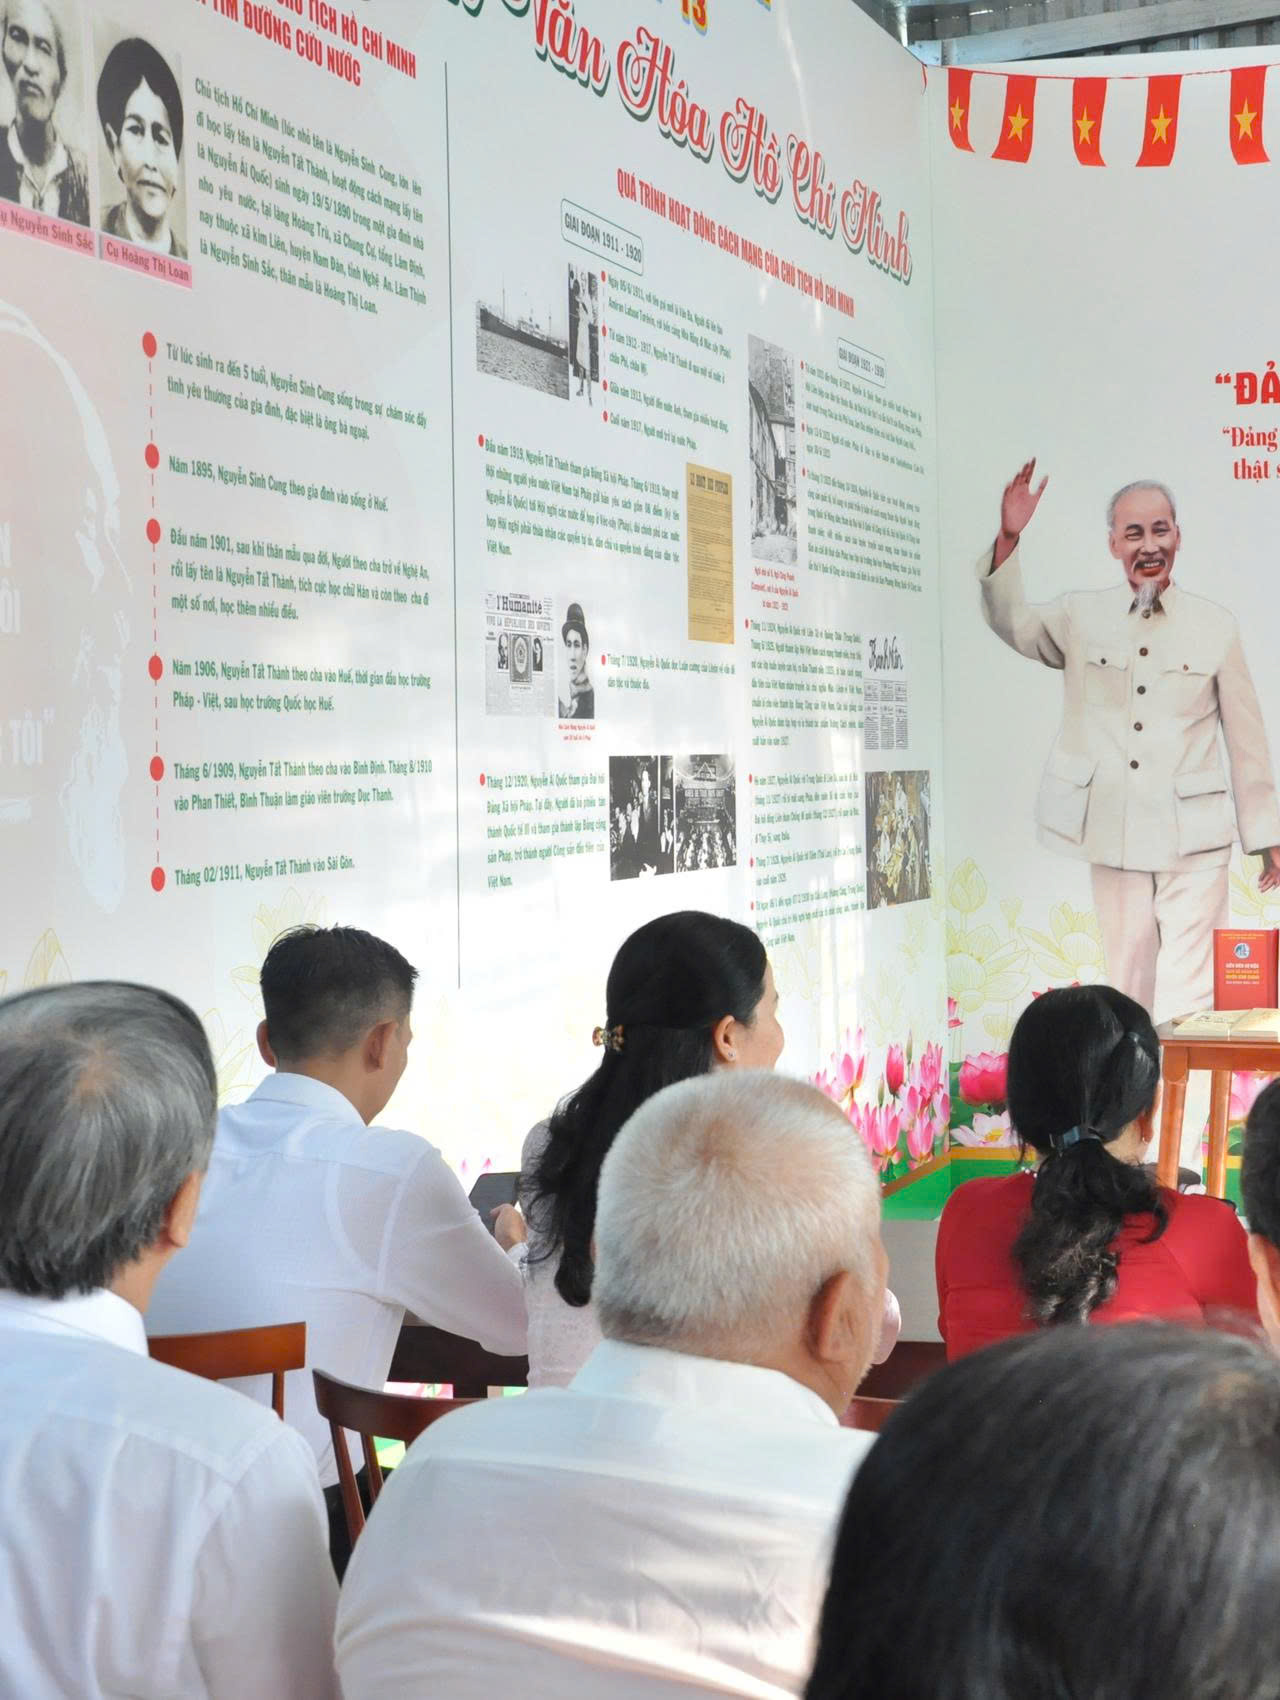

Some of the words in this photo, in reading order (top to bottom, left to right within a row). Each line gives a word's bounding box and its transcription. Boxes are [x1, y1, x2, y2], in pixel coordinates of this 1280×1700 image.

[243, 1, 292, 50] ĐƯỜNG
[296, 29, 322, 67] CỨU
[327, 45, 361, 86] NƯỚC
[309, 0, 337, 35] TỊCH
[341, 11, 358, 46] HỒ
[362, 26, 382, 60] CHÍ
[386, 40, 416, 79] MINH
[617, 26, 713, 153] Hóa
[720, 97, 781, 196] Hồ
[787, 133, 837, 233] Chí
[840, 179, 911, 279] Minh
[10, 210, 49, 236] Nguyễn
[51, 225, 73, 244] Sinh
[76, 233, 94, 251] Sắc
[565, 213, 579, 233] GIAI
[581, 220, 600, 244] ĐOẠN
[602, 232, 619, 253] 1911
[625, 243, 642, 263] 1920
[617, 168, 637, 202] QUÁ
[639, 180, 666, 217] TRÌNH
[669, 198, 691, 232] HOẠT
[693, 211, 716, 245] ĐỘNG
[718, 223, 739, 257] CÁCH
[741, 237, 763, 269] MẠNG
[765, 250, 779, 278] CỦA
[781, 260, 796, 288] CHỦ
[838, 291, 855, 318] MINH
[106, 241, 119, 261] Cụ
[121, 248, 150, 271] Hoàng
[152, 257, 166, 278] Thị
[168, 263, 190, 282] Loan
[169, 456, 188, 474] Năm
[192, 460, 215, 482] 1895,
[218, 465, 247, 486] Nguyễn
[249, 472, 266, 488] Sinh
[268, 475, 287, 496] Cung
[289, 480, 305, 496] theo
[307, 484, 318, 500] gia
[320, 486, 334, 502] đình
[337, 490, 348, 504] vào
[350, 492, 366, 510] sống
[368, 494, 372, 508] ở
[374, 496, 388, 512] Huế.
[1234, 458, 1268, 482] thật
[175, 869, 200, 887] Tháng
[204, 864, 242, 882] 02/1911,
[245, 859, 273, 881] Nguyễn
[275, 860, 287, 876] Tất
[289, 858, 311, 874] Thành
[313, 858, 325, 872] vào
[327, 856, 338, 869] Sài
